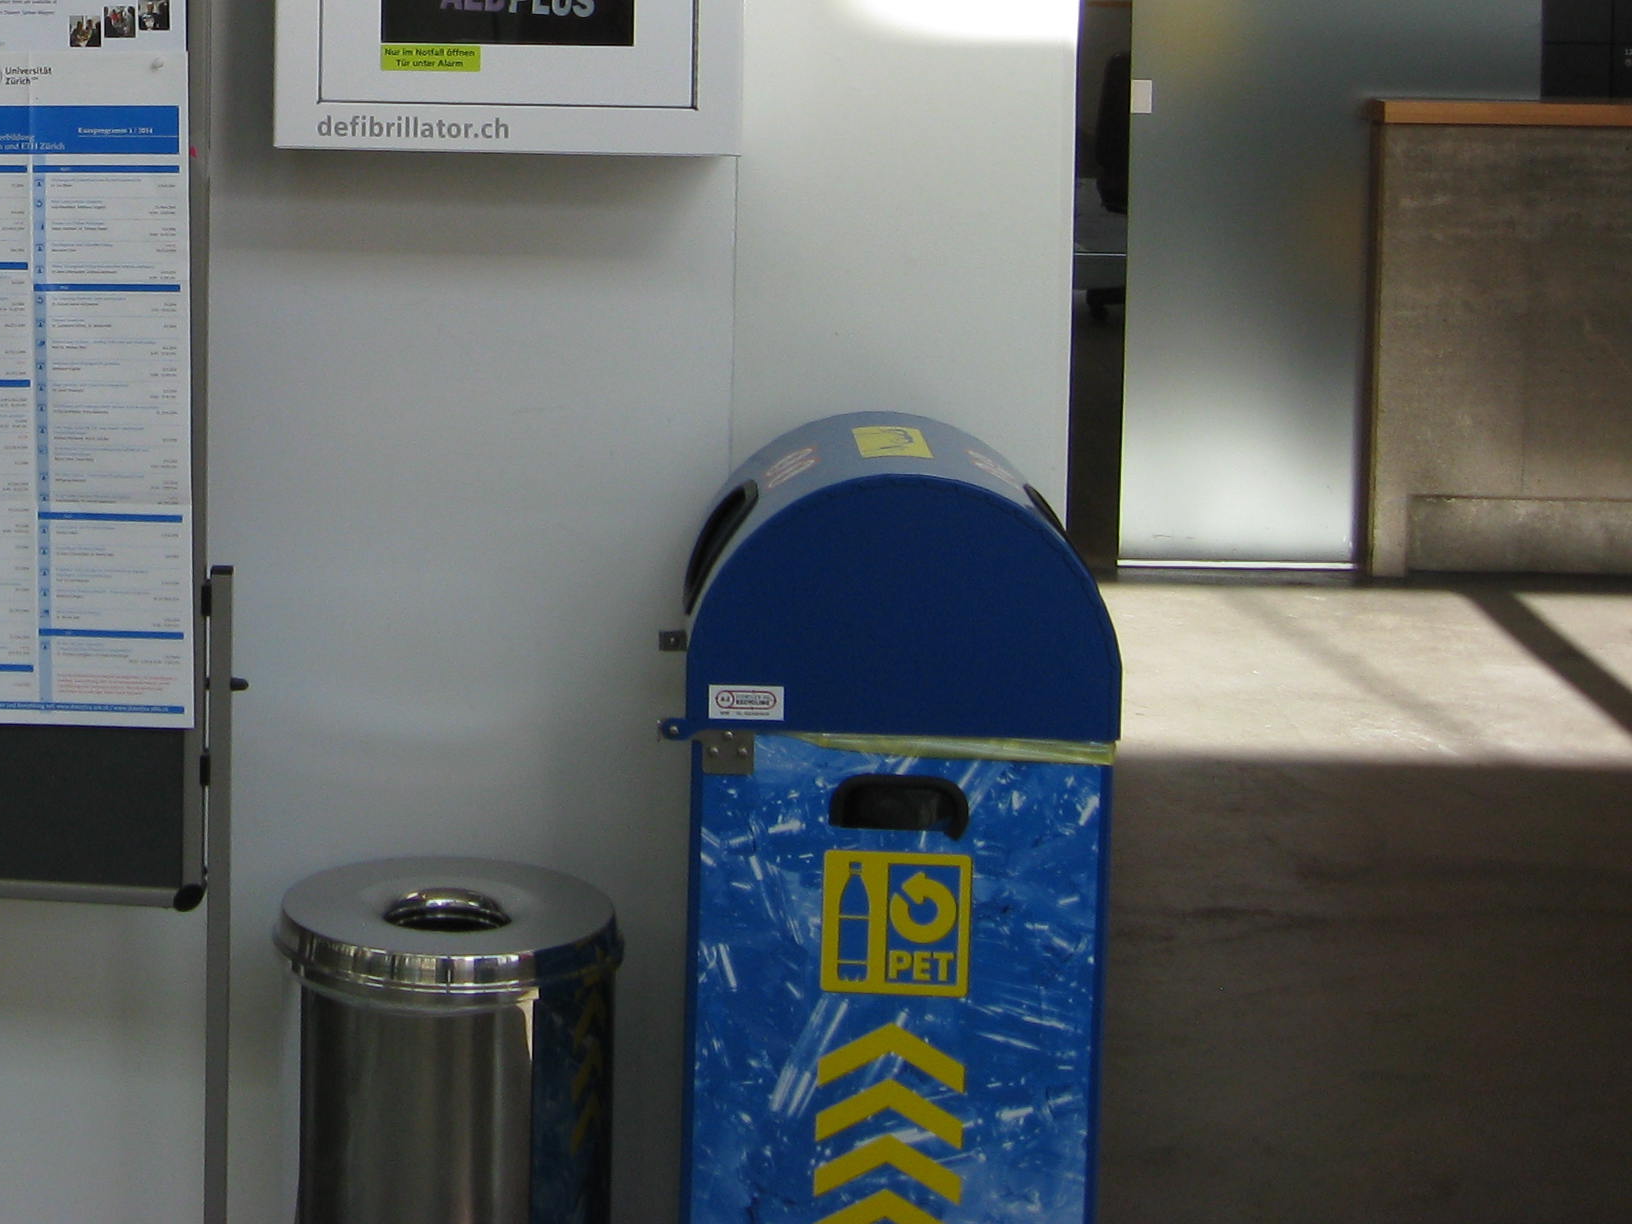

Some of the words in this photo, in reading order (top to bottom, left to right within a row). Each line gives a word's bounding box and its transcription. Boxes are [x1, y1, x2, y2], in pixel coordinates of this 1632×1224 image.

[385, 48, 399, 56] Nur
[416, 48, 444, 56] Notfall
[5, 66, 52, 76] Universität
[317, 115, 510, 139] defibrillator.ch
[888, 951, 954, 981] PET
